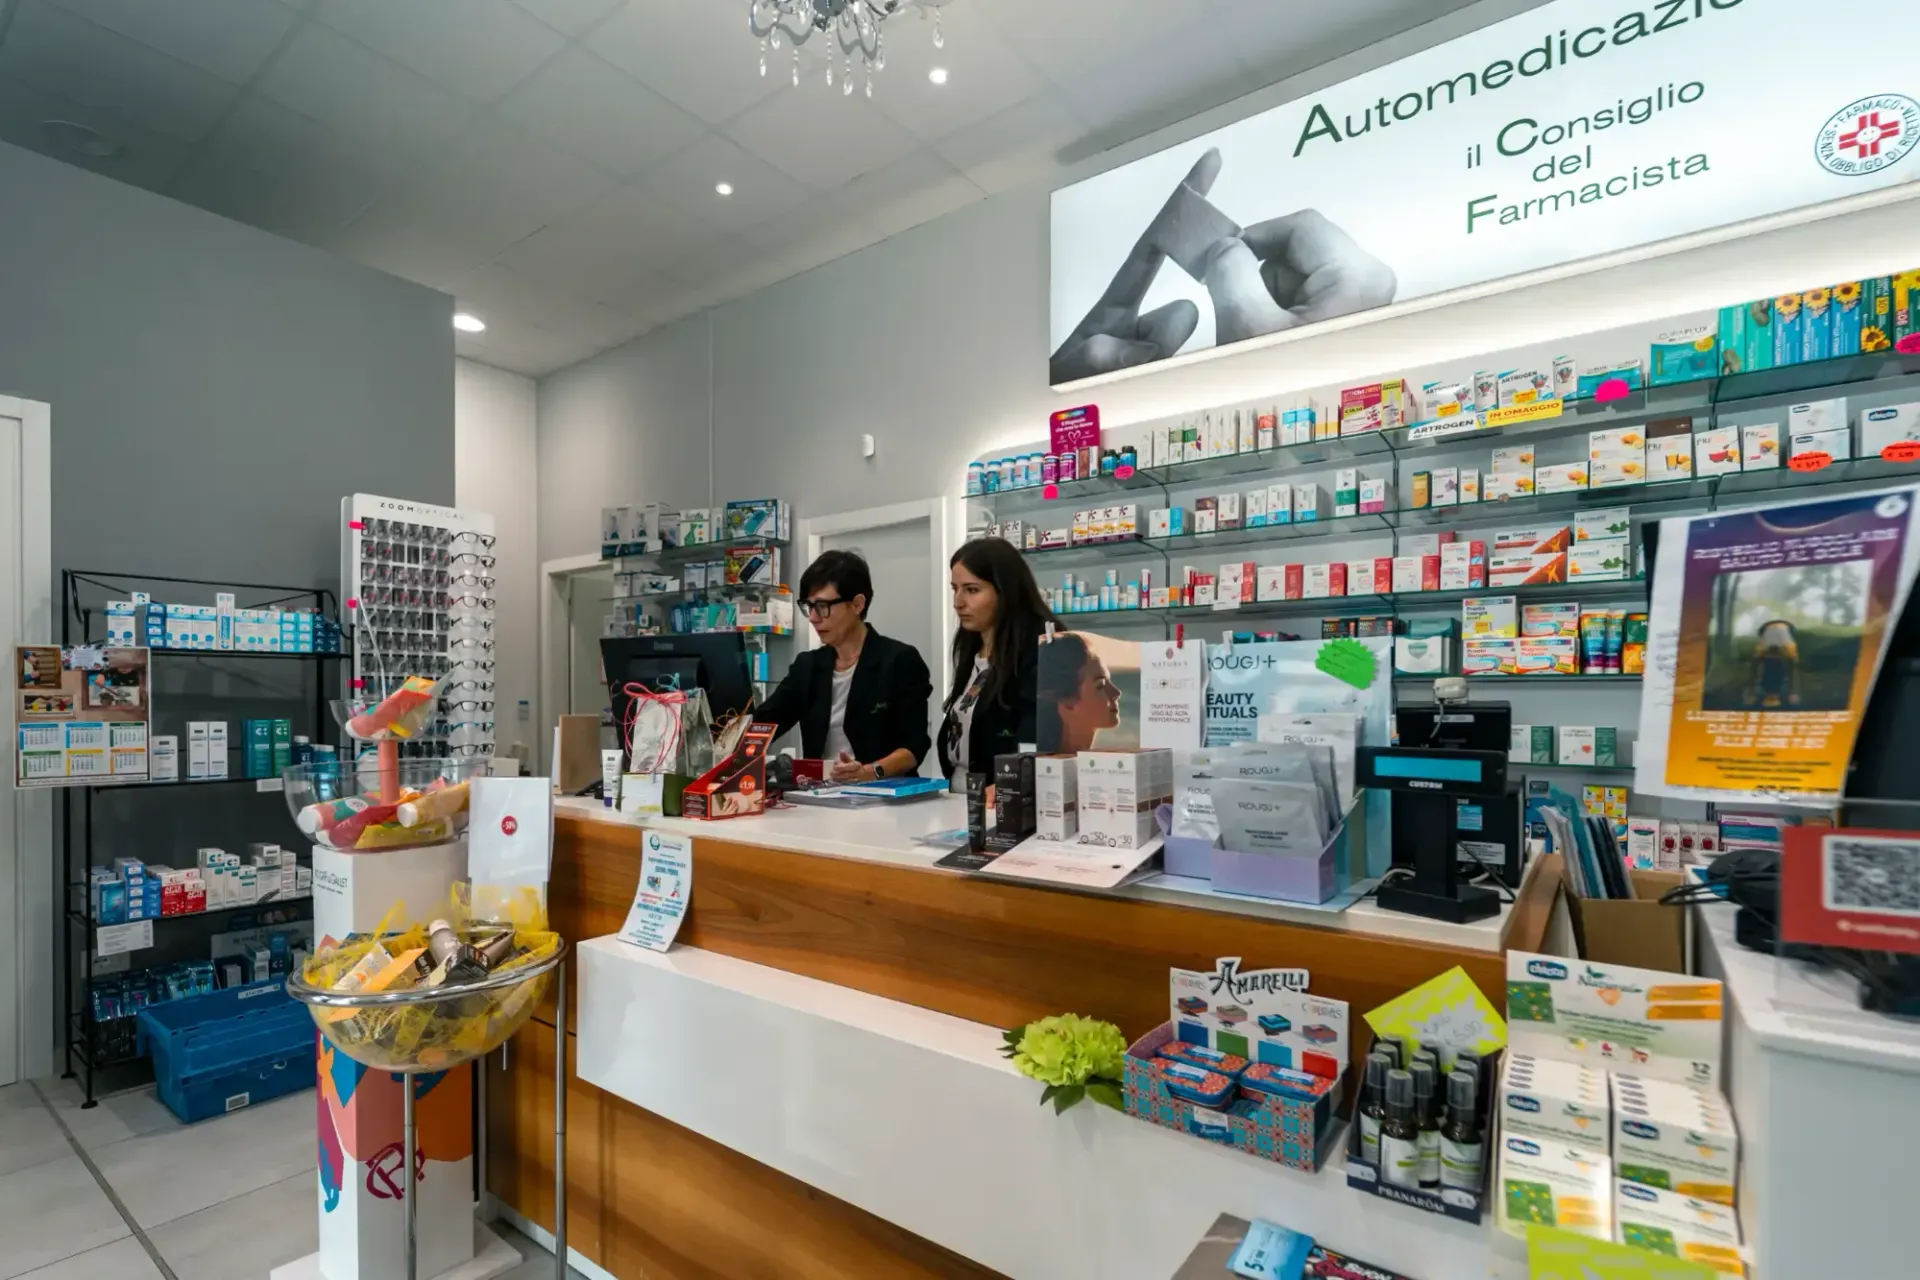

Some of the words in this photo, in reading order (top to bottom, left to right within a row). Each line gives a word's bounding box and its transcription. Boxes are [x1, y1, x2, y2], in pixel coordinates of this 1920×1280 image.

[1837, 98, 1901, 122] FARMACO
[1466, 144, 1481, 169] il
[1496, 80, 1705, 157] Consiglio
[1820, 129, 1837, 160] SENZA
[1829, 157, 1884, 172] OBBLIGO
[1885, 147, 1902, 160] DI
[1531, 145, 1592, 183] del
[1466, 152, 1710, 234] Farmacista
[1489, 412, 1503, 420] IN
[1506, 402, 1561, 416] OMAGGIO
[1413, 420, 1474, 435] ARTROGEN
[380, 502, 414, 512] ZOOM
[1206, 692, 1254, 706] EAUTY
[1206, 706, 1258, 719] ITUALS
[1408, 780, 1443, 789] CUSTOM
[1378, 1185, 1445, 1212] PRANAROM
